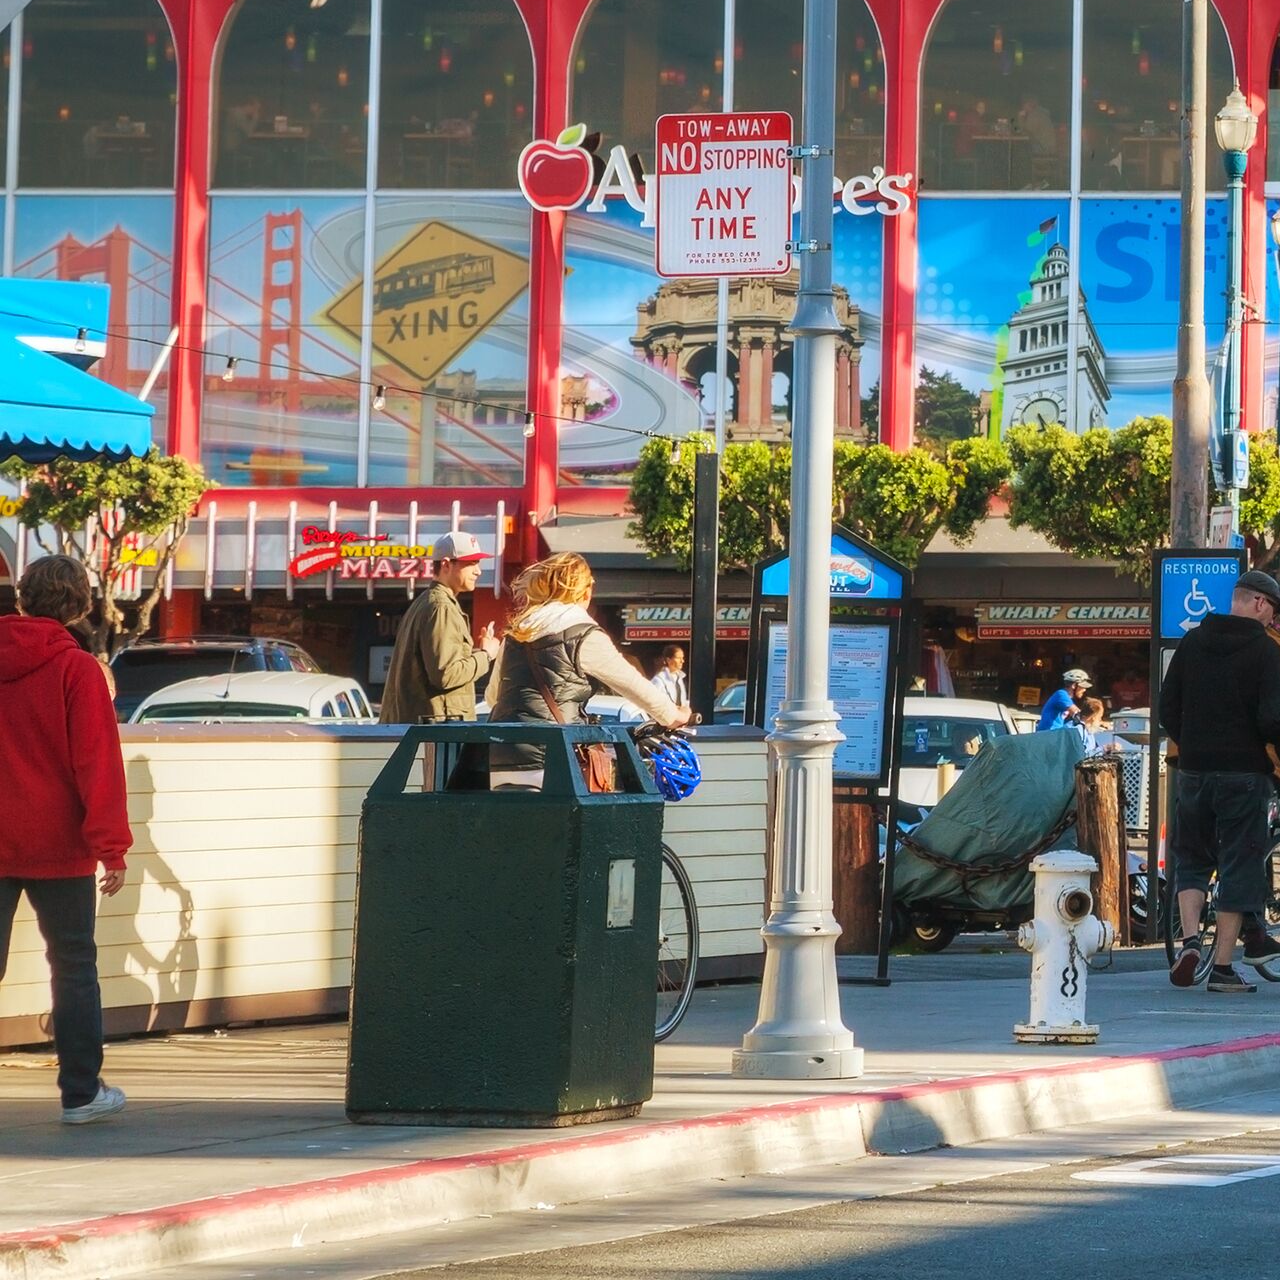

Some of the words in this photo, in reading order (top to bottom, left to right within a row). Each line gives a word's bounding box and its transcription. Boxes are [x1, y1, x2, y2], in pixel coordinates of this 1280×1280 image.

[678, 119, 771, 138] TOW-AWAY
[661, 141, 697, 172] NO
[704, 147, 785, 170] STOPPING
[696, 187, 752, 210] ANY
[691, 216, 757, 240] TIME
[387, 300, 479, 345] XING
[1164, 563, 1237, 574] RESTROOMS
[989, 606, 1061, 619] WHARF
[1067, 606, 1150, 619] CENTRAL
